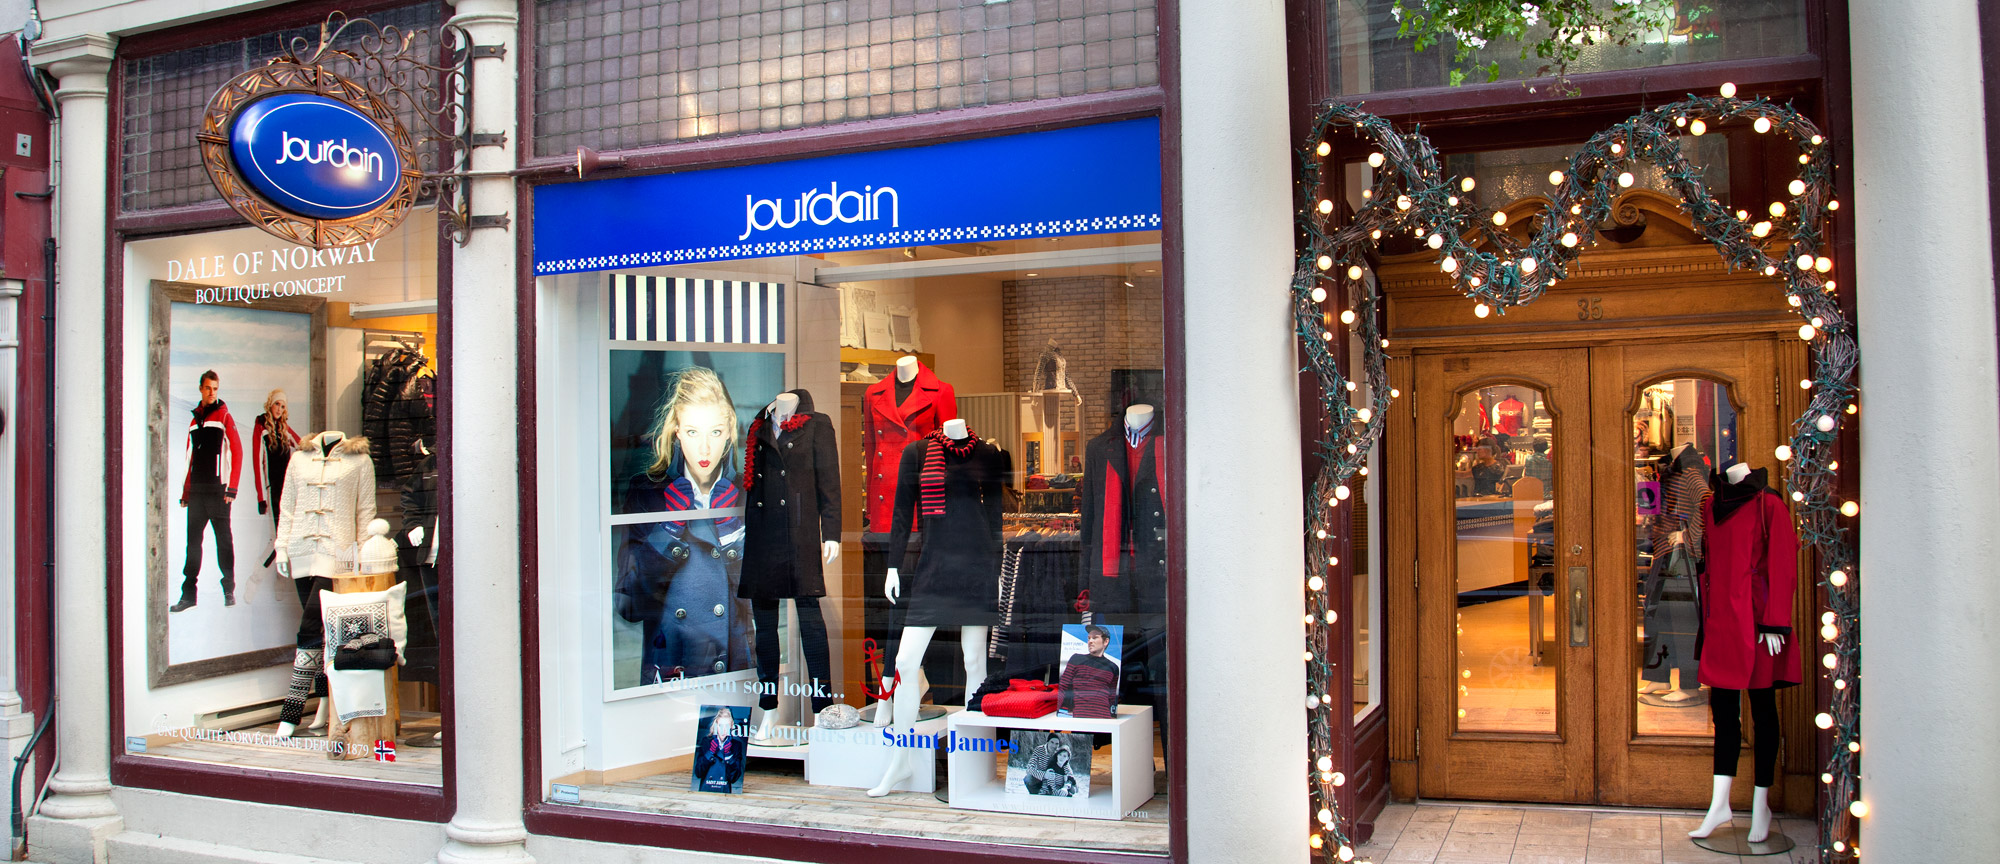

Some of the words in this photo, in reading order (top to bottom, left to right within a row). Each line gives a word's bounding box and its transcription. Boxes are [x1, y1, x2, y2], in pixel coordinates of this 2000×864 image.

[167, 253, 226, 282] DALE
[233, 252, 264, 276] OF
[271, 239, 380, 271] NORWAY
[195, 283, 270, 305] BOUTIQUE
[273, 275, 345, 297] CONCEPT
[1577, 297, 1604, 320] 35
[652, 664, 663, 688] À
[743, 680, 778, 696] son
[784, 676, 845, 699] look...
[158, 726, 178, 738] UNE
[180, 727, 222, 741] QUALITÉ
[226, 730, 301, 749] NORVÉGIENNE
[304, 738, 343, 753] DEPUIS
[346, 743, 369, 756] 1879
[765, 721, 846, 747] toujours
[853, 731, 876, 746] en
[882, 726, 941, 751] Saint
[945, 730, 1019, 754] James
